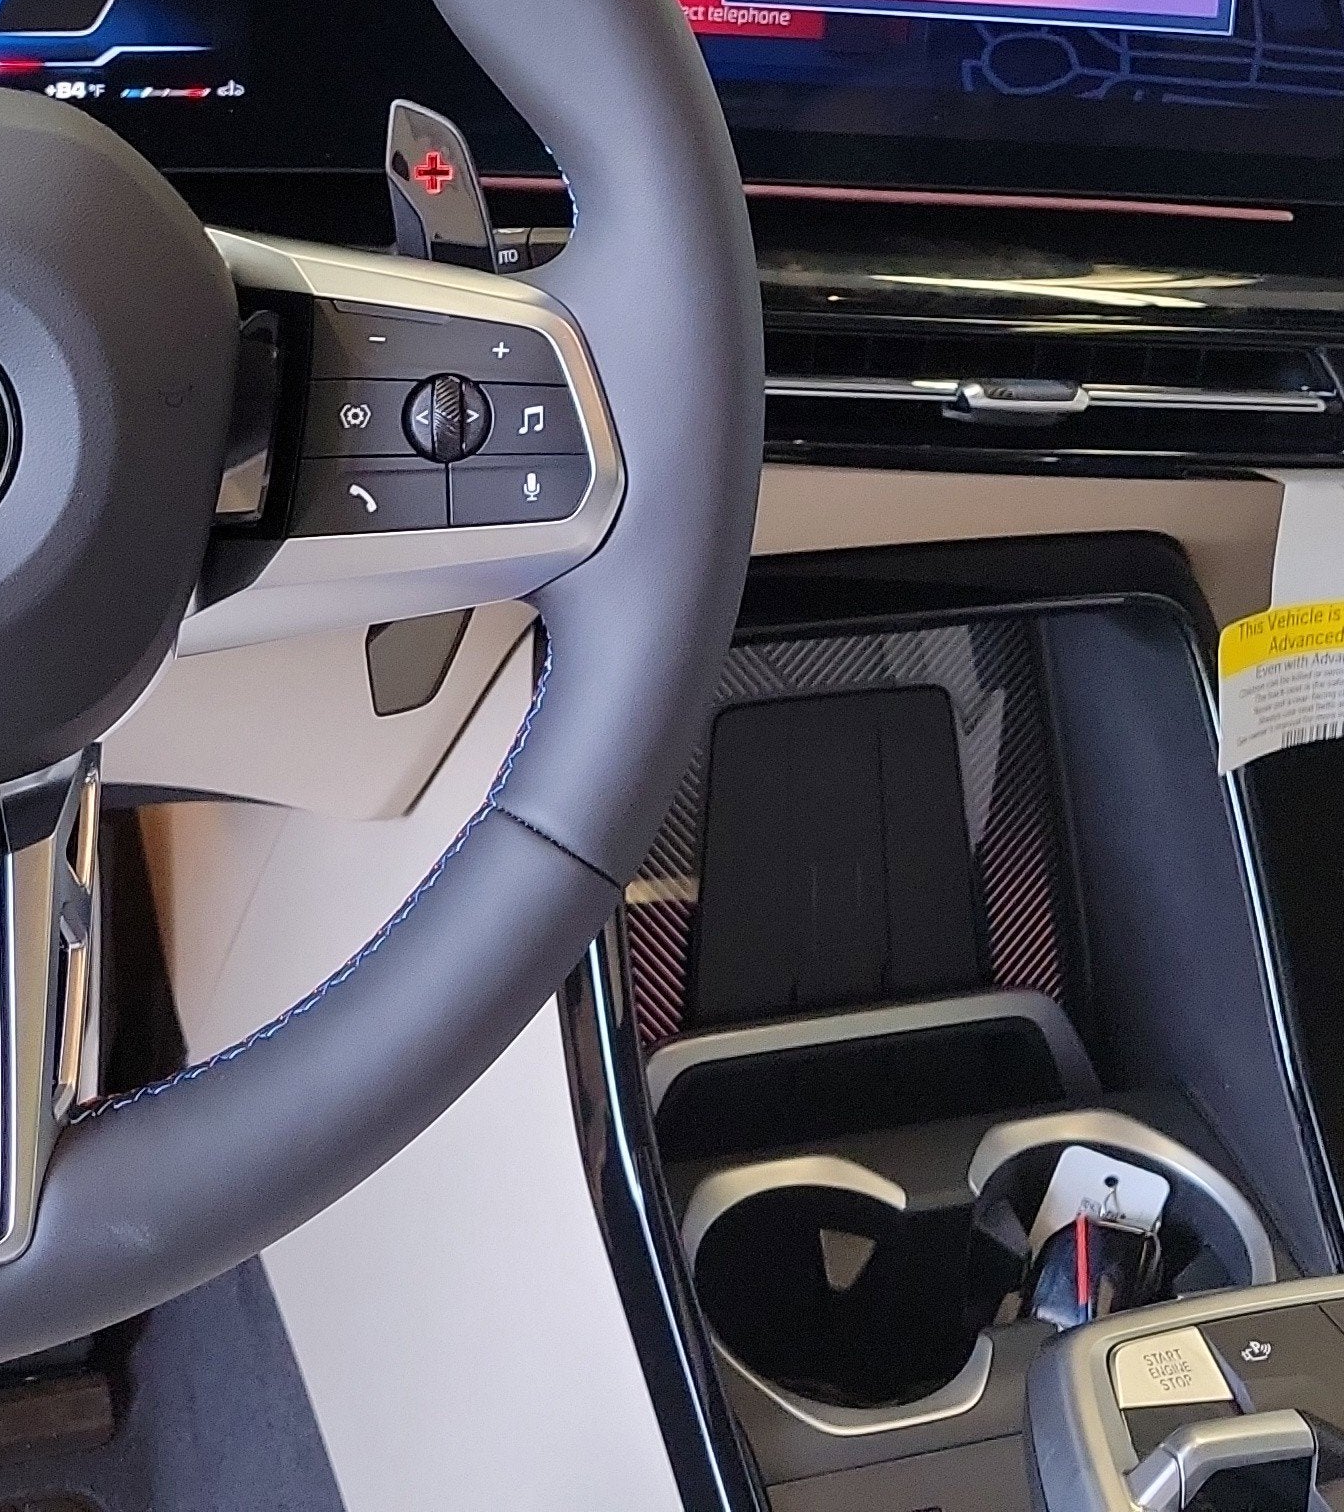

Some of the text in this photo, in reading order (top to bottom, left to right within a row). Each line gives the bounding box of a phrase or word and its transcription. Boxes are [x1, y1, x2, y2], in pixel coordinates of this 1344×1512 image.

[707, 6, 792, 26] telephone
[1238, 621, 1265, 642] This
[1268, 607, 1324, 631] Vehicle
[1327, 604, 1341, 622] is
[1268, 625, 1344, 655] Advanced
[1284, 655, 1309, 671] with
[1143, 1348, 1182, 1368] START
[1148, 1360, 1192, 1380] ENGINE
[1159, 1374, 1192, 1392] STOP
